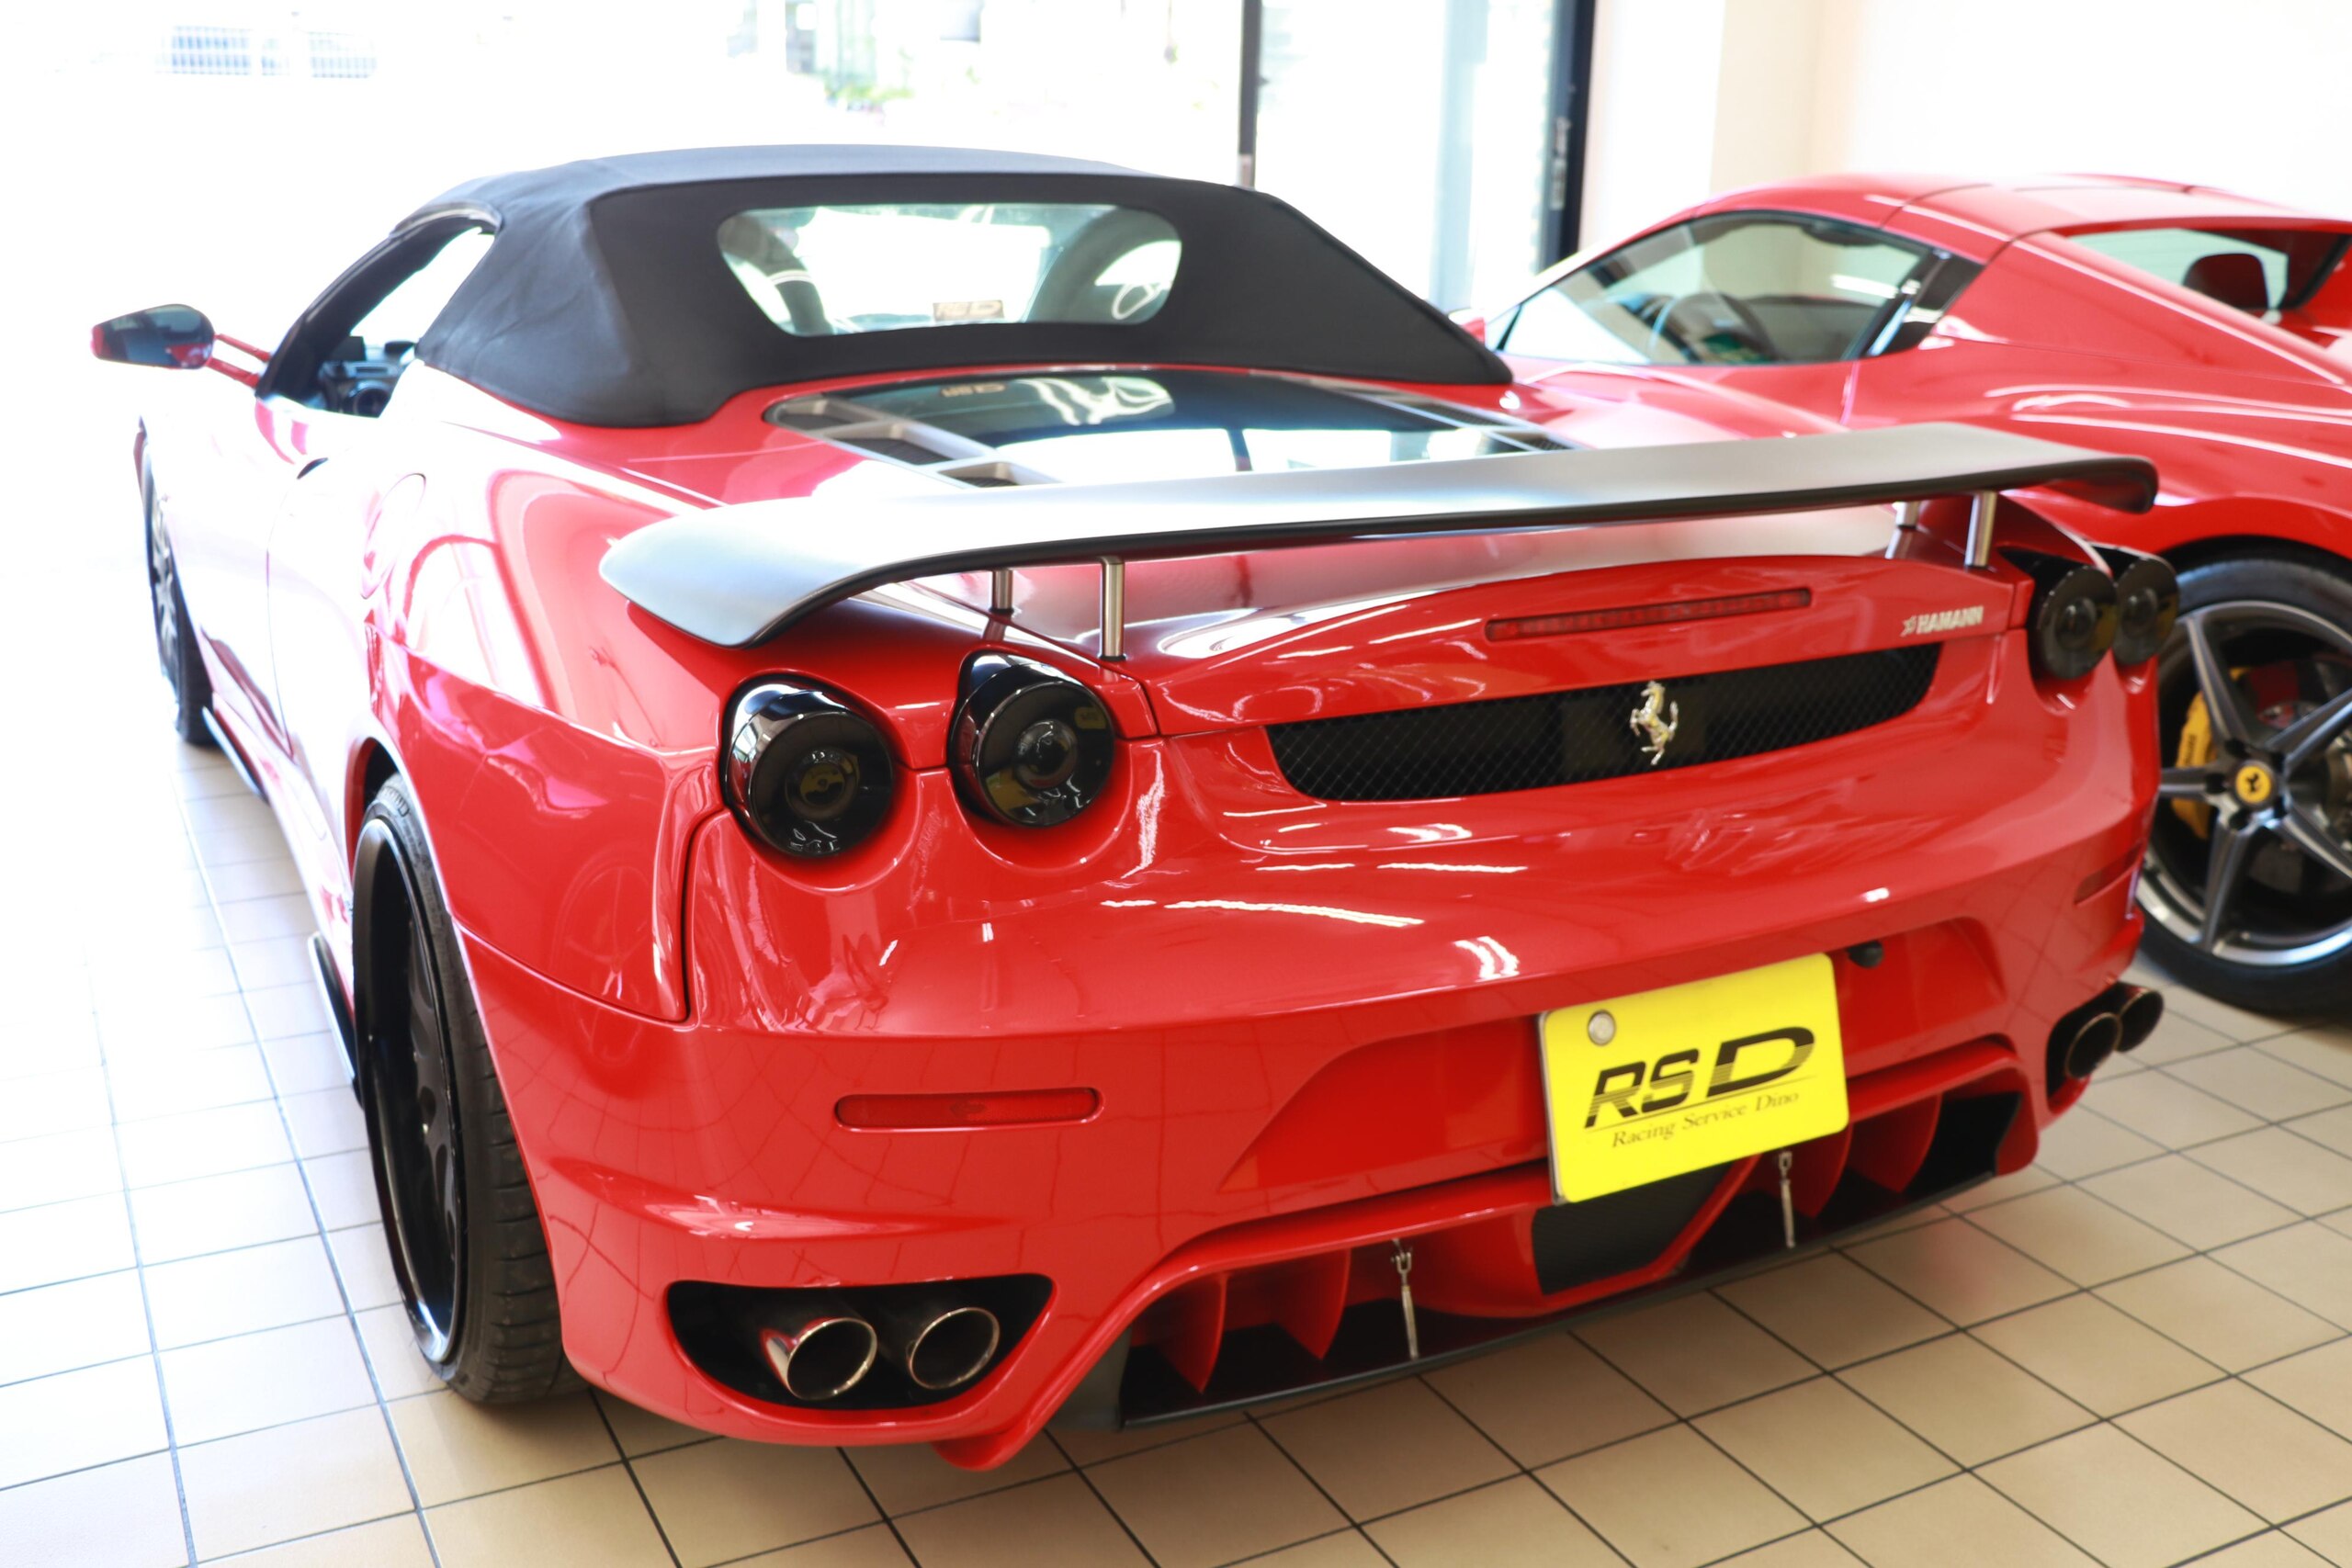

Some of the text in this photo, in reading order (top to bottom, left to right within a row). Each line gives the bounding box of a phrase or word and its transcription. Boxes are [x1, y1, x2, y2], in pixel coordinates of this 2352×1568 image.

[1916, 604, 1984, 635] HAMANN
[1584, 1026, 1815, 1129] RSD
[1611, 1092, 1799, 1148] Racing Service Dino
